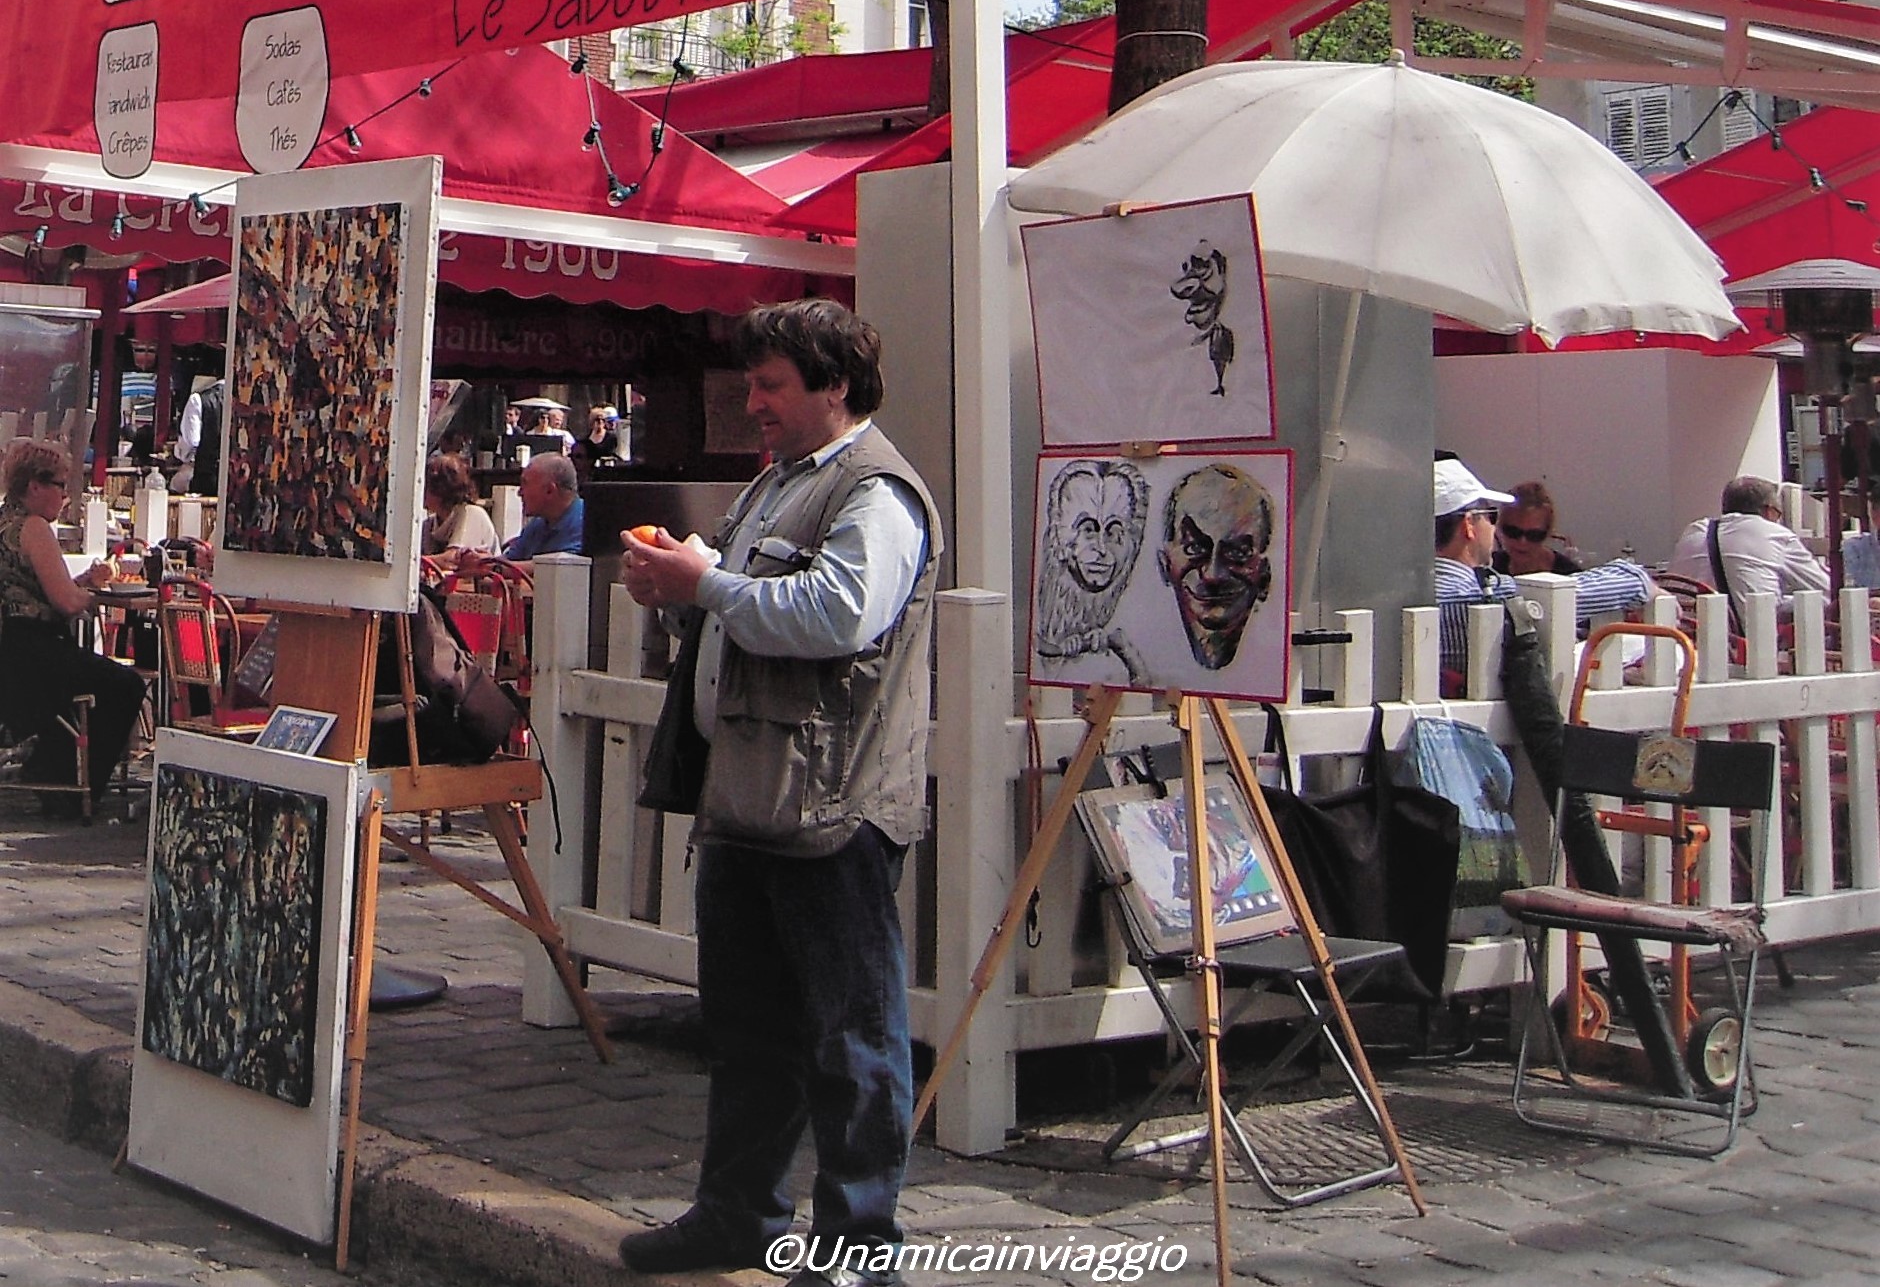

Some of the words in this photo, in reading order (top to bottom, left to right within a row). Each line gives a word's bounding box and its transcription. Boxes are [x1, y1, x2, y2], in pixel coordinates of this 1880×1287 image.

[264, 31, 302, 61] Sodas
[266, 78, 302, 107] Cafés
[108, 130, 149, 159] Crêpes
[269, 126, 297, 152] Thés
[14, 181, 94, 225] La
